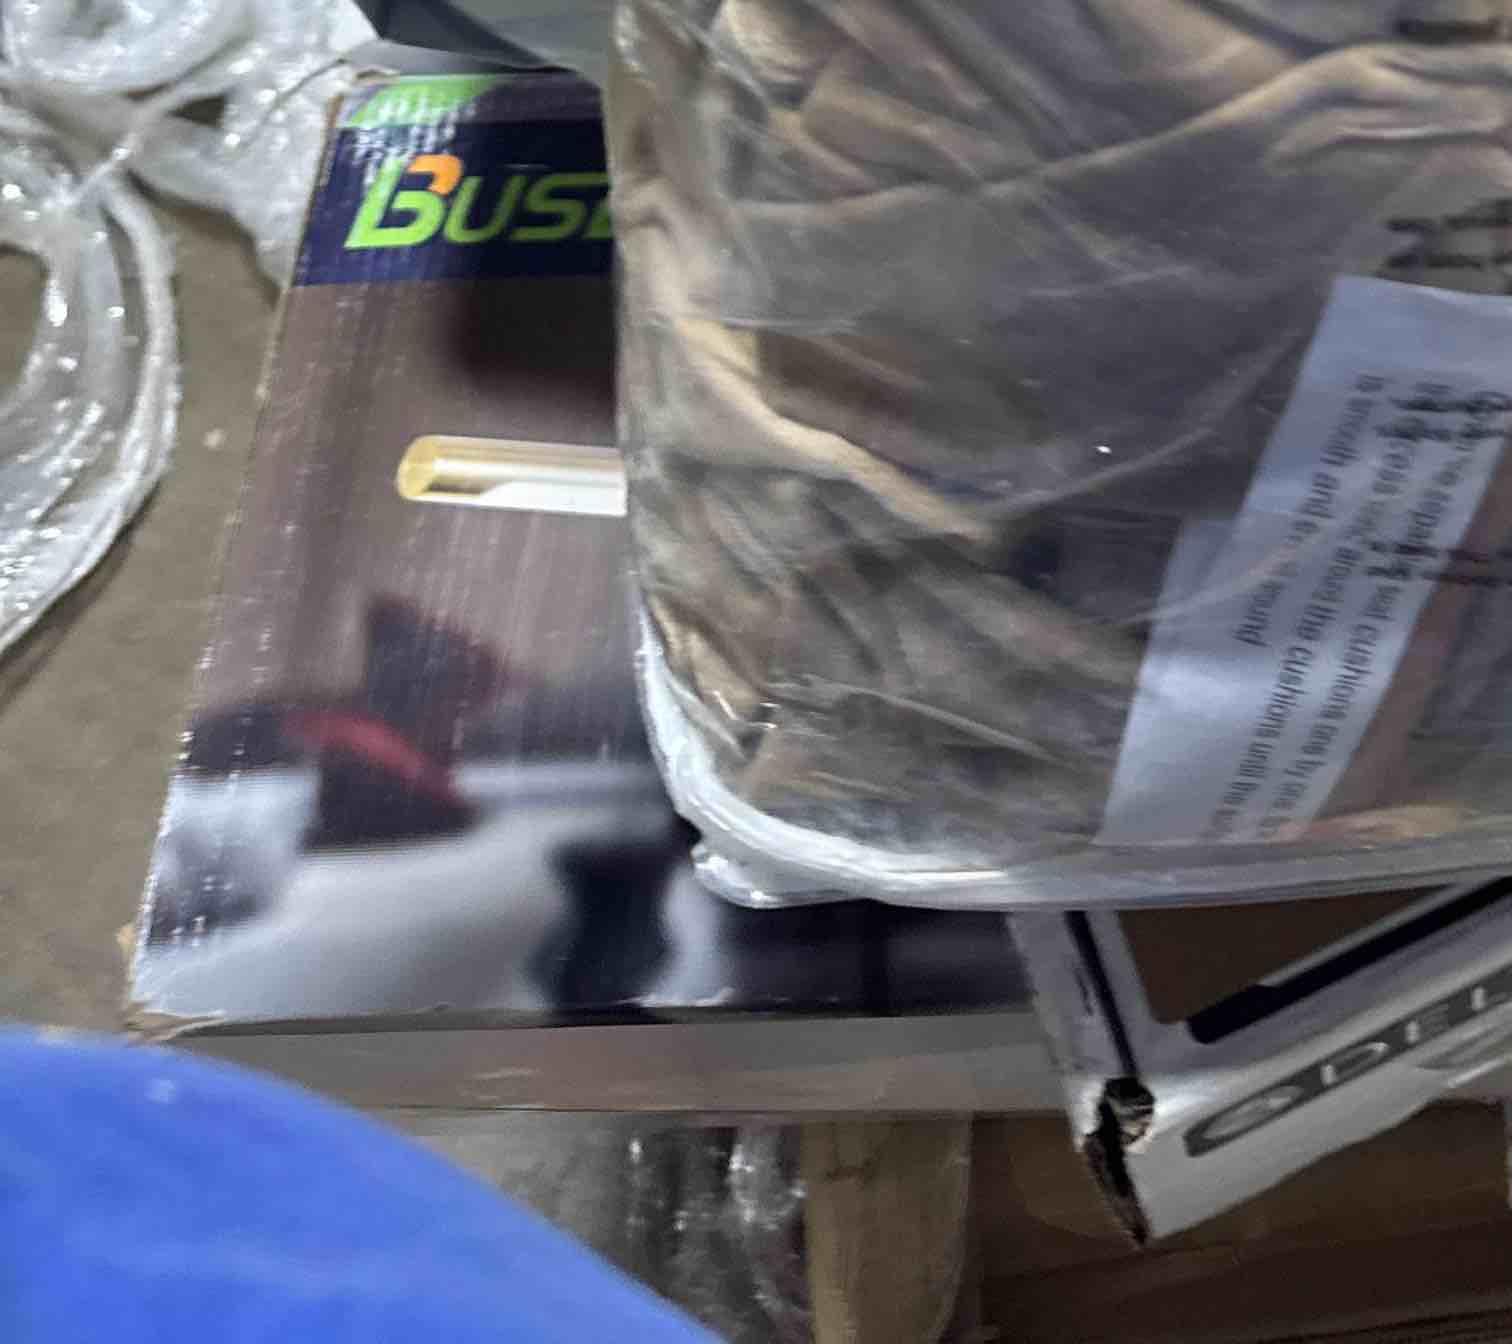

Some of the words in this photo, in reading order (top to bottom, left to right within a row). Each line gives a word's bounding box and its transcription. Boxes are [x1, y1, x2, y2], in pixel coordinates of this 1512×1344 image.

[1288, 472, 1341, 520] and
[1299, 606, 1338, 641] the
[1256, 647, 1314, 739] cushions
[1319, 625, 1382, 719] cushions
